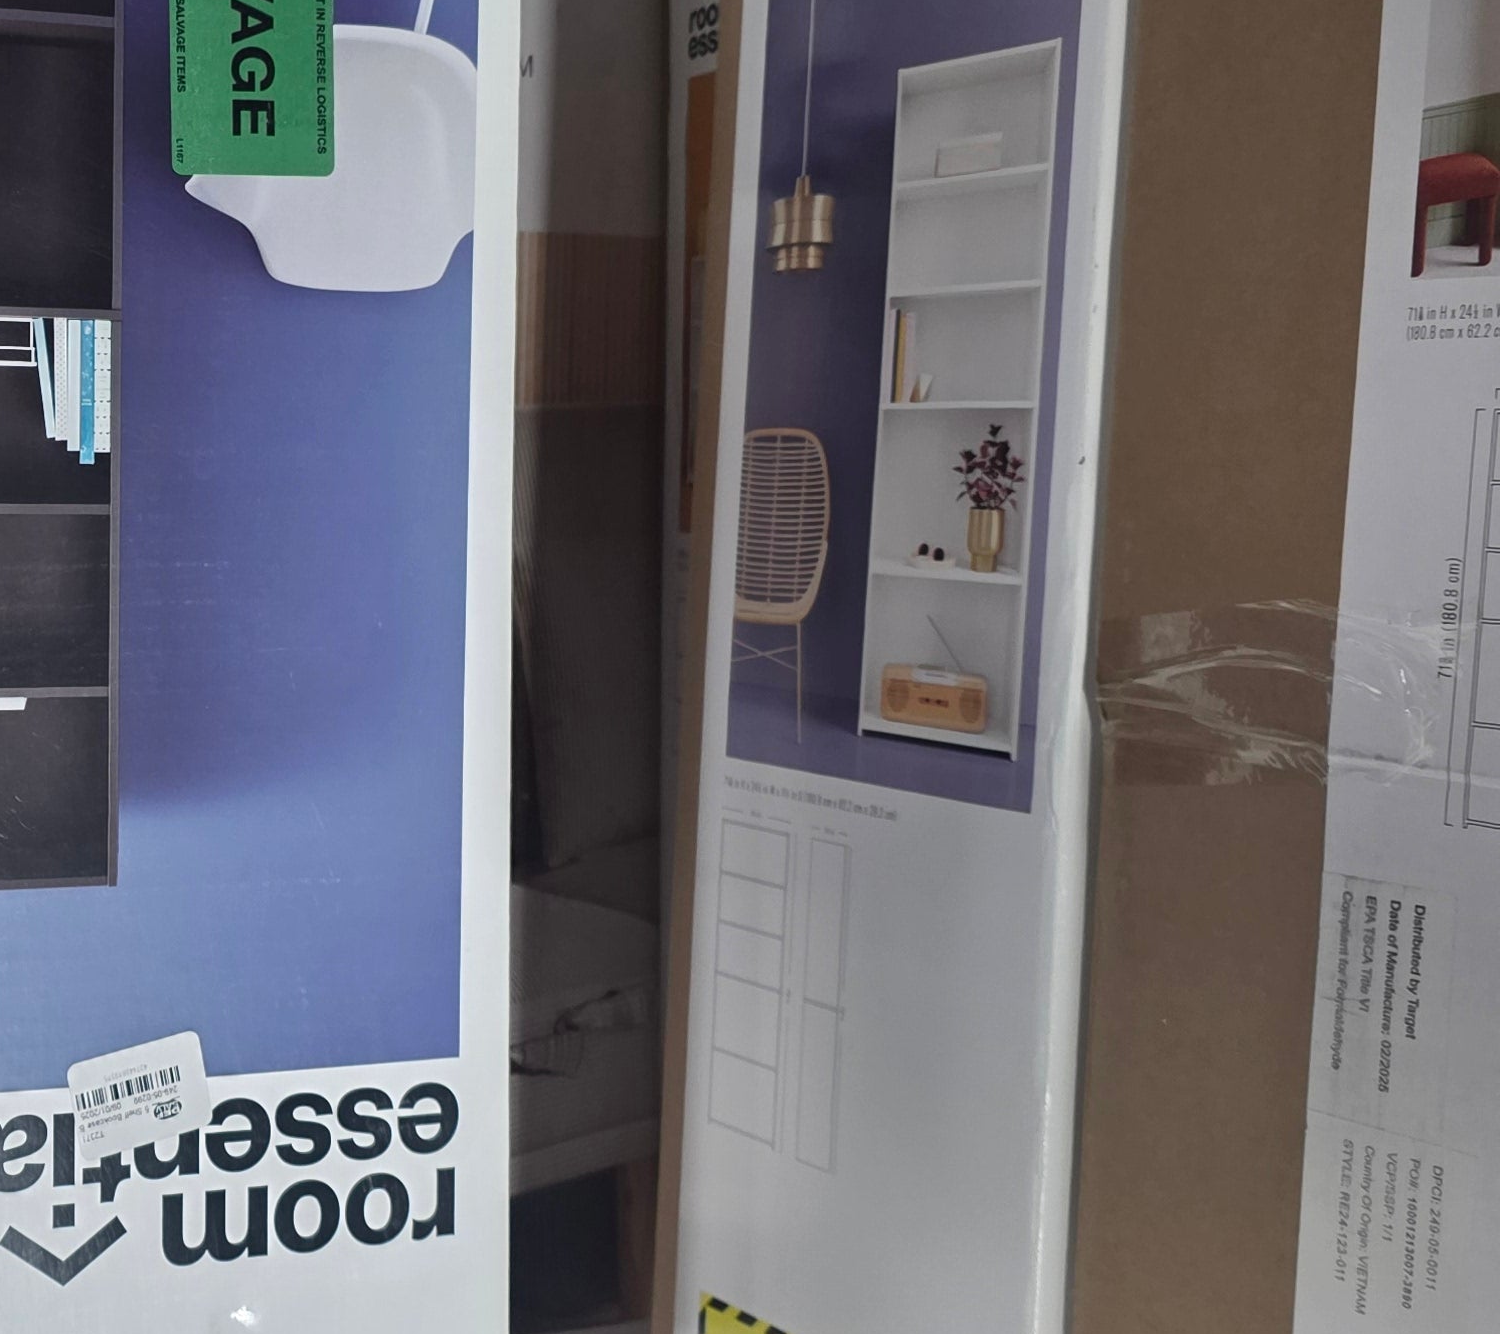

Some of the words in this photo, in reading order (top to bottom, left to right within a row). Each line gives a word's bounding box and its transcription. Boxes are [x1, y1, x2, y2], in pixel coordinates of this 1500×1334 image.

[315, 7, 326, 21] IN
[316, 23, 326, 84] REVERSE
[176, 55, 186, 93] ITEMS
[316, 86, 327, 154] LOGISTICS
[1425, 307, 1437, 320] in
[1438, 327, 1455, 338] cm
[1338, 890, 1354, 956] Compliant
[1365, 895, 1377, 924] EPA
[1388, 899, 1402, 928] Date
[1361, 927, 1376, 964] TSCA
[1387, 928, 1399, 950] of
[1410, 904, 1426, 976] Distributed
[1337, 958, 1349, 977] for
[1359, 968, 1373, 995] Title
[1381, 950, 1398, 1035] Manufacture:
[1406, 978, 1421, 996] by
[1404, 998, 1420, 1040] Target
[85, 1112, 124, 1131] Bookcase
[122, 1106, 144, 1120] Shelf
[1360, 1145, 1376, 1193] Country
[1431, 1165, 1444, 1204] DPCI:
[160, 1165, 455, 1267] room
[1361, 1194, 1373, 1212] Of
[1357, 1212, 1372, 1252] Origin:
[1355, 1256, 1369, 1315] VIETNAM
